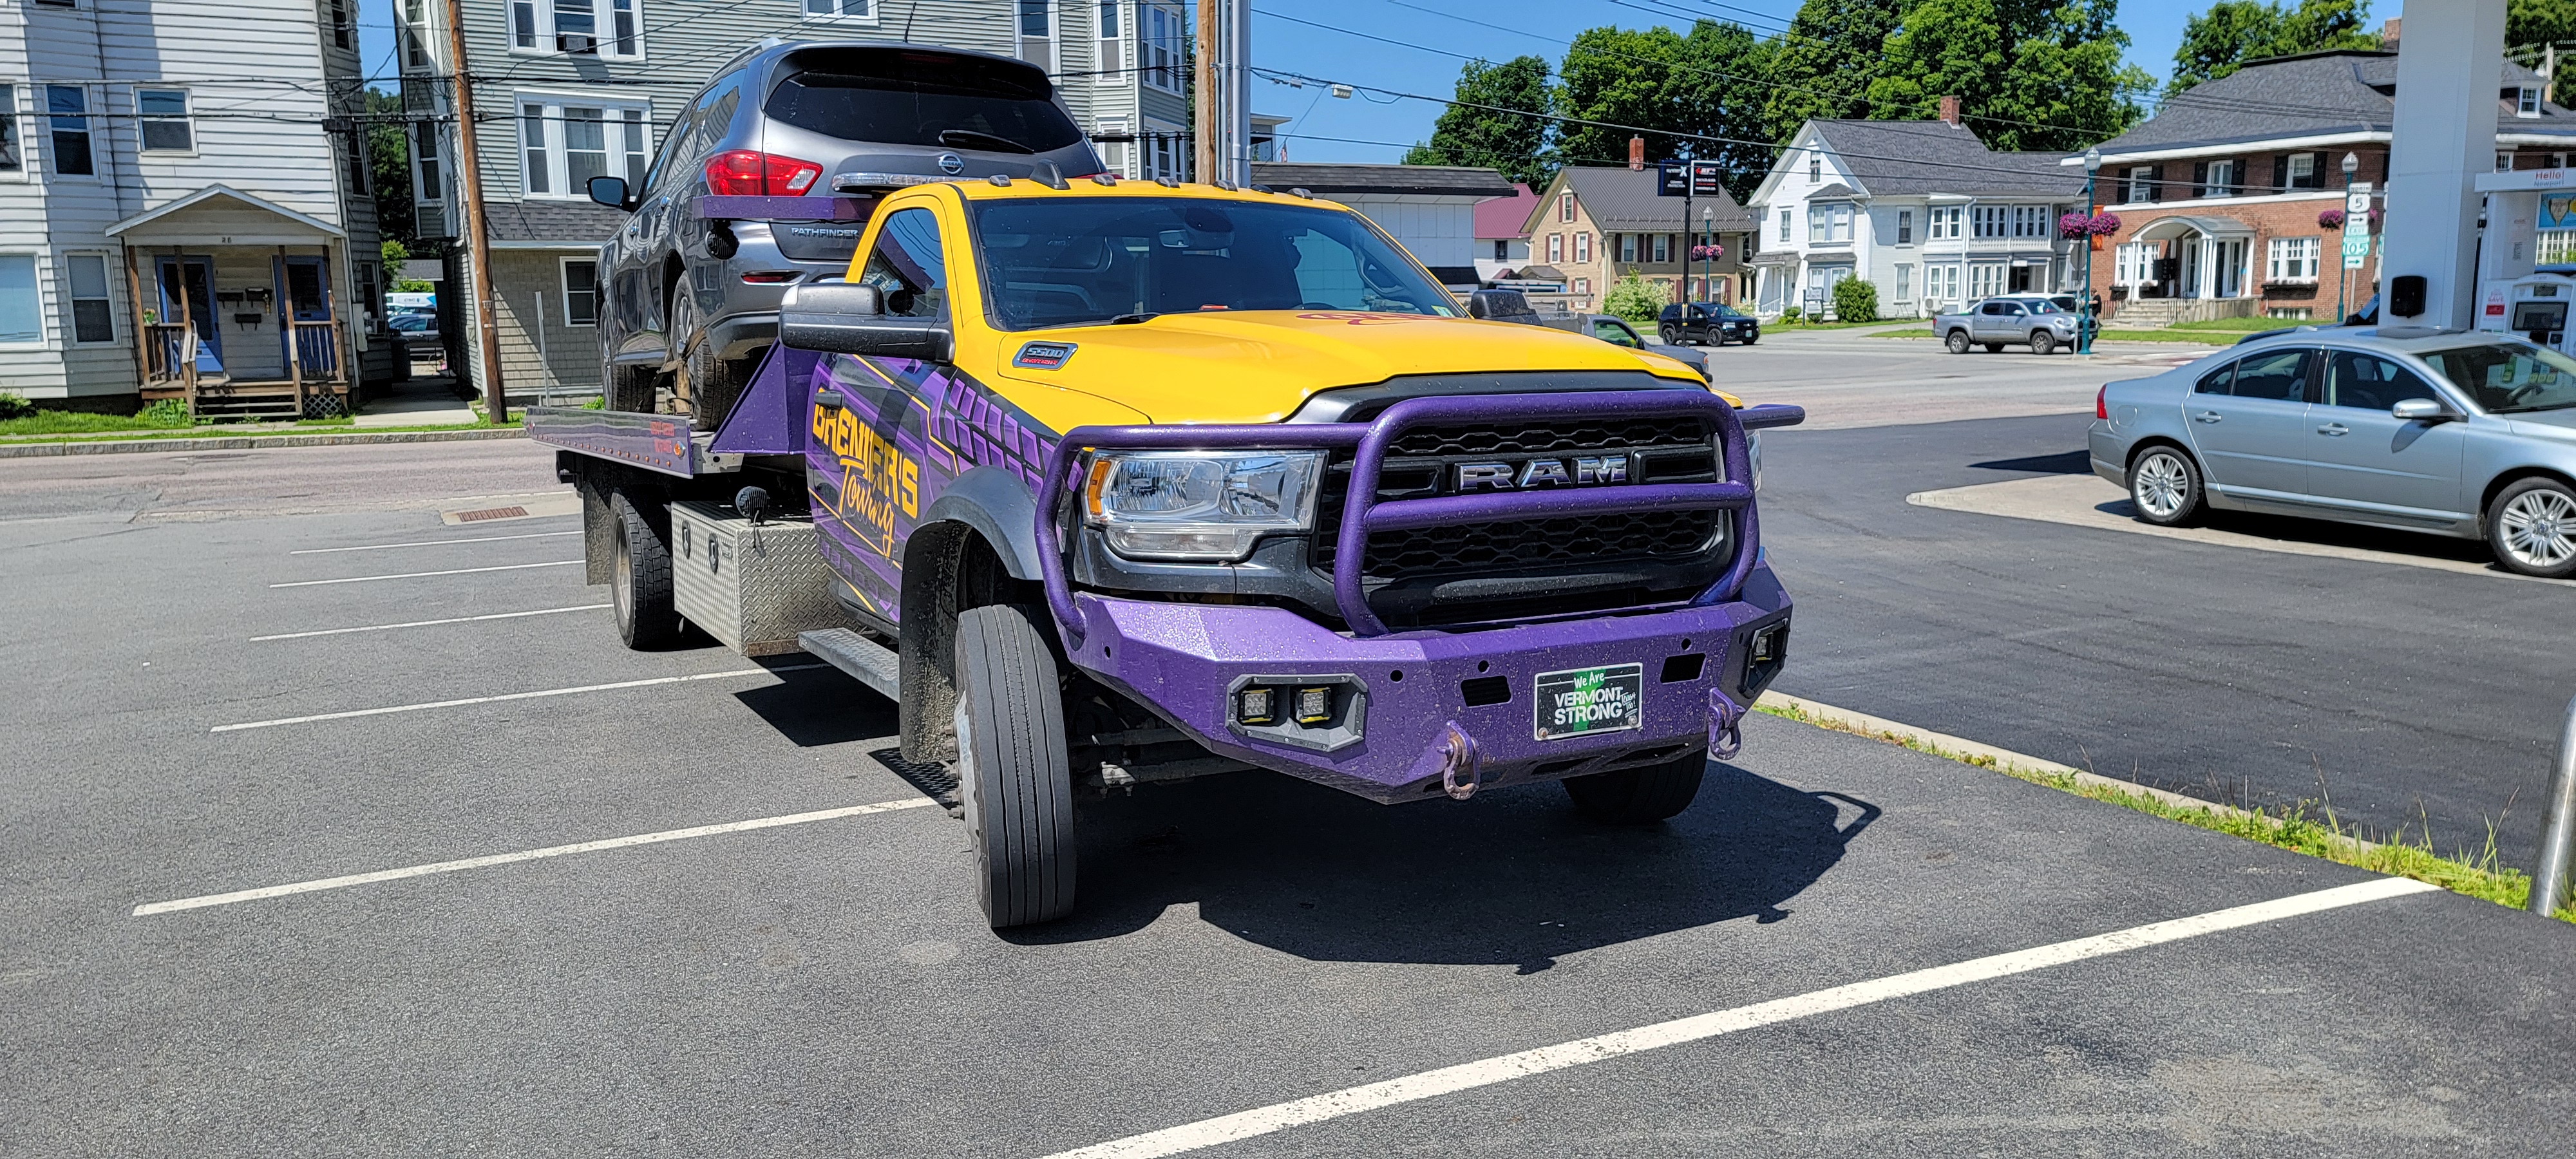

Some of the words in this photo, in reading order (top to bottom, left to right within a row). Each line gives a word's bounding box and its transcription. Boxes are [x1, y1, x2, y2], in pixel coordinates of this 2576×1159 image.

[2535, 170, 2564, 180] Hello!
[2534, 179, 2564, 187] Newport
[2354, 197, 2363, 209] 5
[791, 227, 858, 237] PATHFINDER
[2344, 243, 2367, 254] 105
[1027, 347, 1065, 358] 5500
[1455, 457, 1627, 491] RAM
[839, 458, 896, 558] Towing
[1573, 676, 1587, 689] We
[1589, 672, 1605, 686] Are
[1554, 686, 1624, 708] VERMONT
[1554, 701, 1622, 725] STRONG
